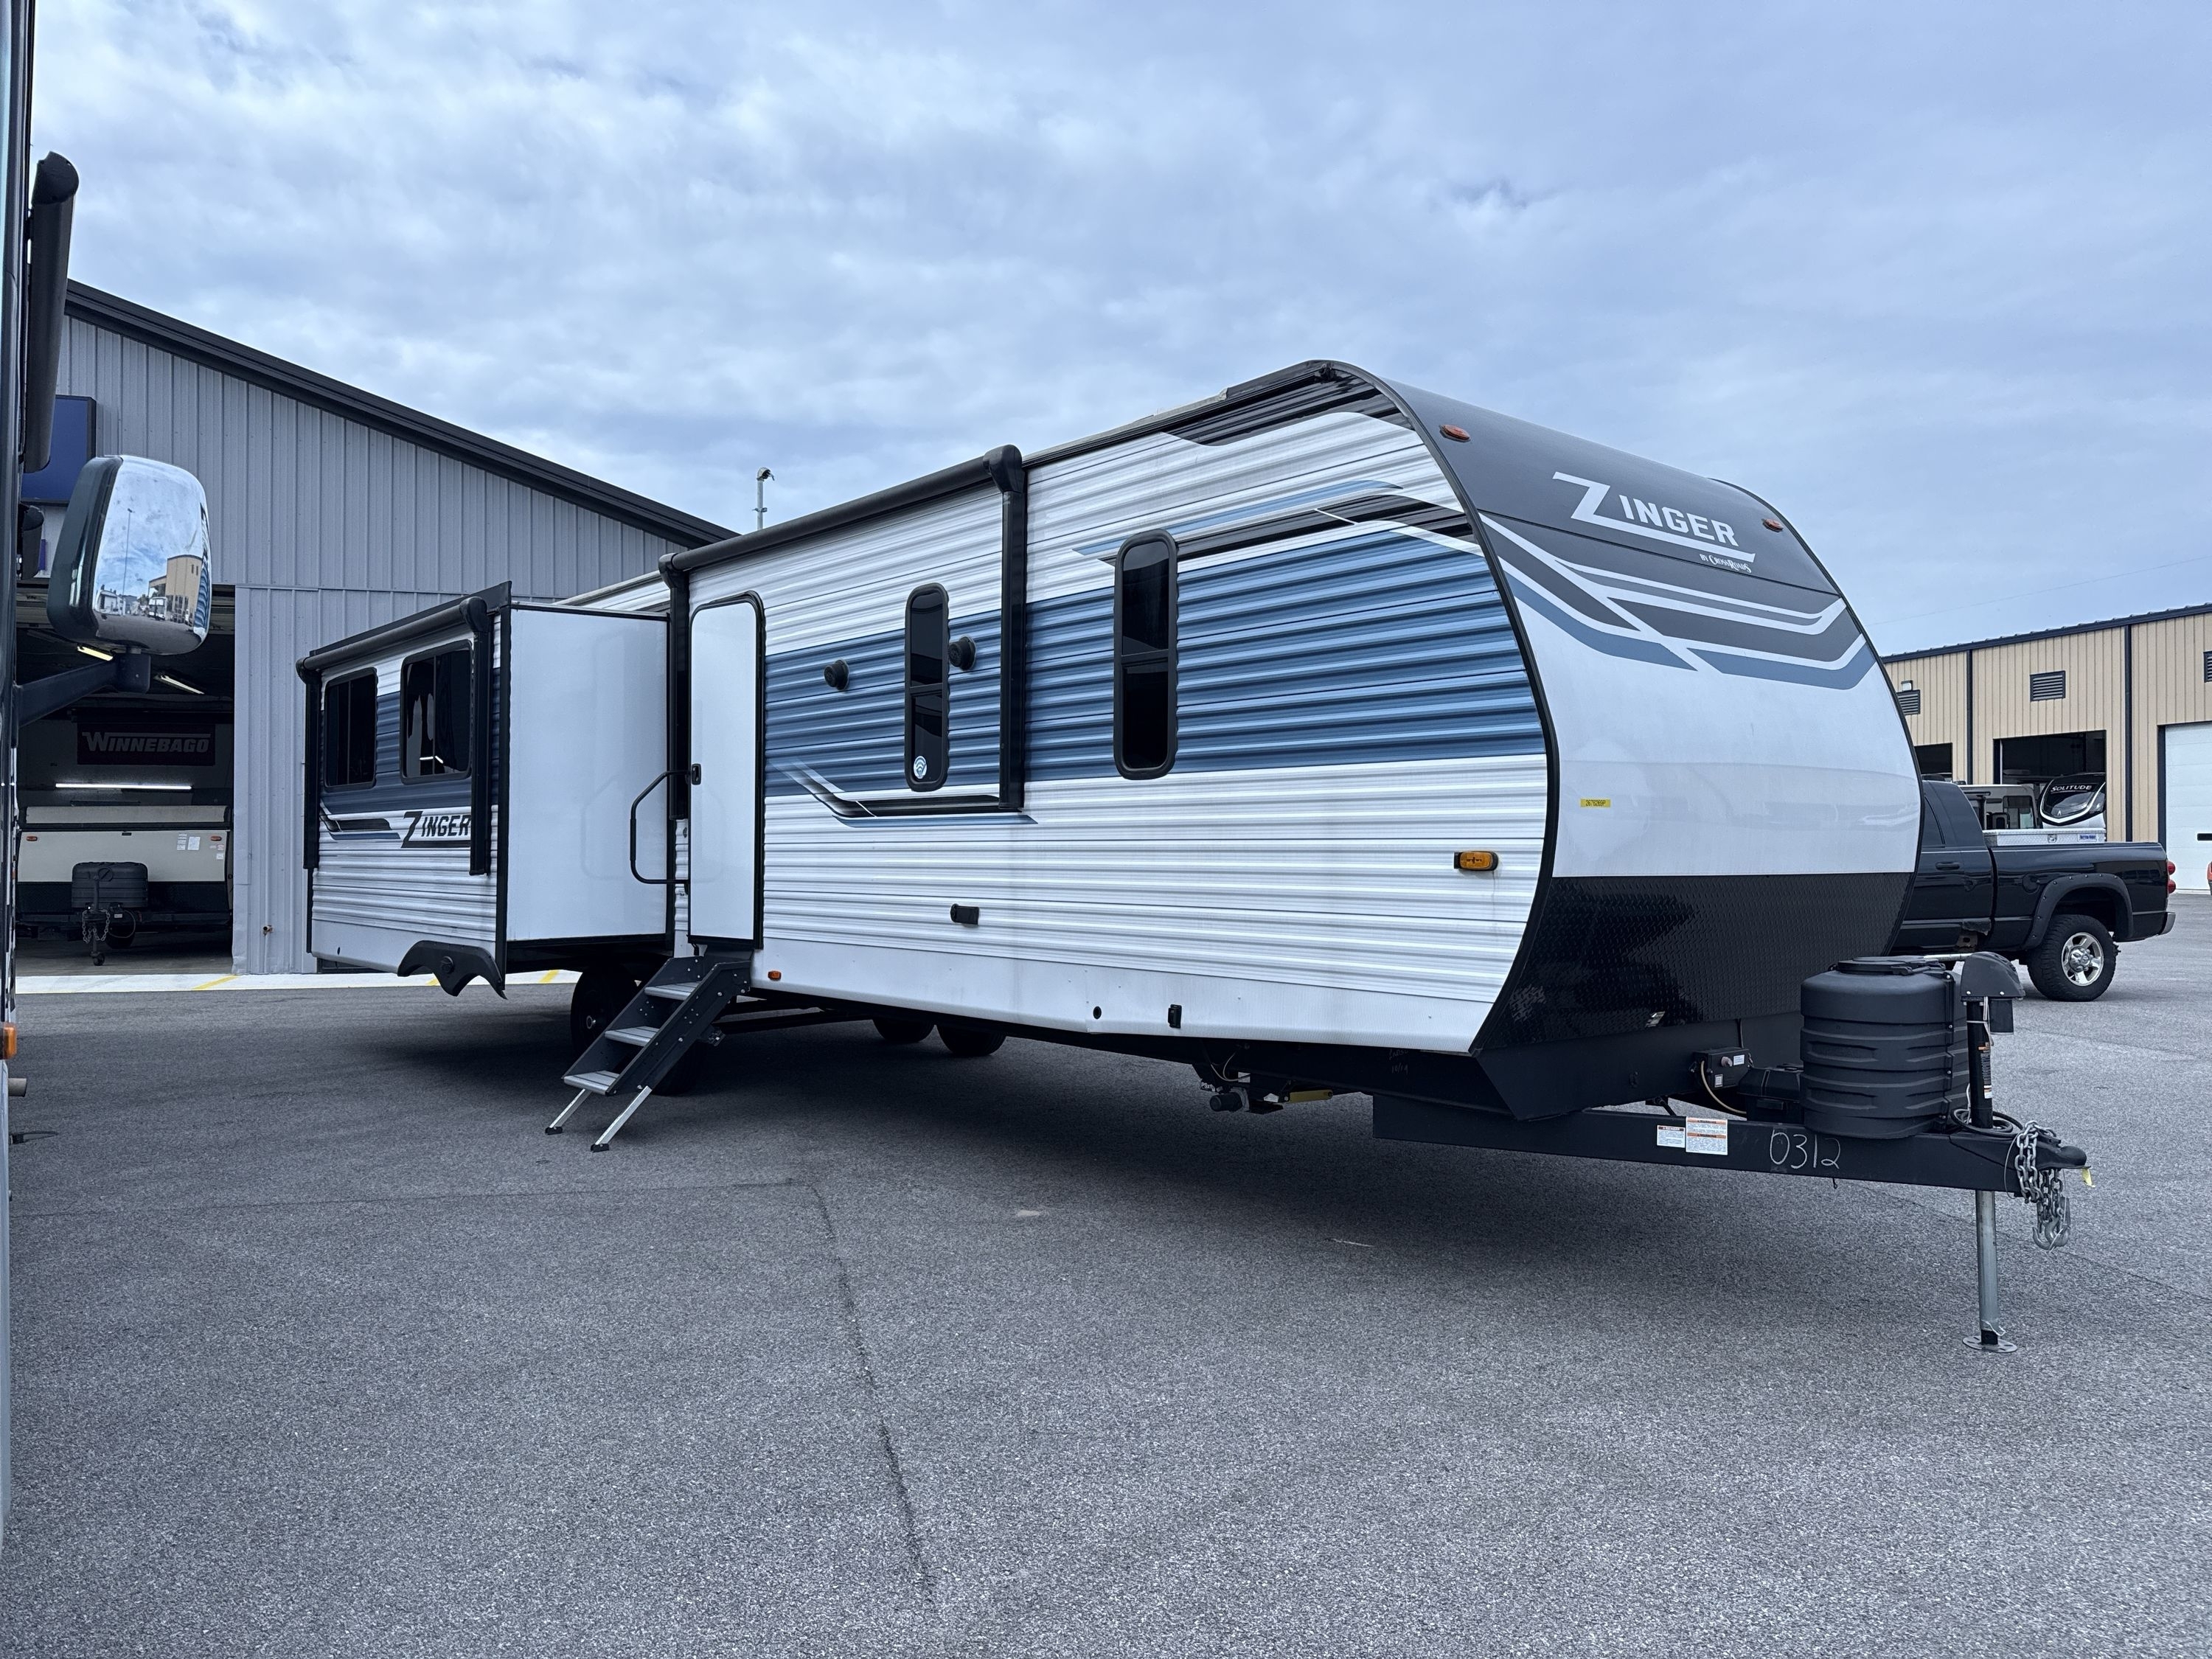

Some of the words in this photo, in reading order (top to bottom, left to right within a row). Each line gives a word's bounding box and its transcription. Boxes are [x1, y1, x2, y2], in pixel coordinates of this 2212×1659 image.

[1552, 472, 1756, 563] ZINGER
[82, 731, 211, 753] WINNEBAGO
[401, 810, 472, 848] ZINGER
[1770, 1130, 1840, 1169] 0312
